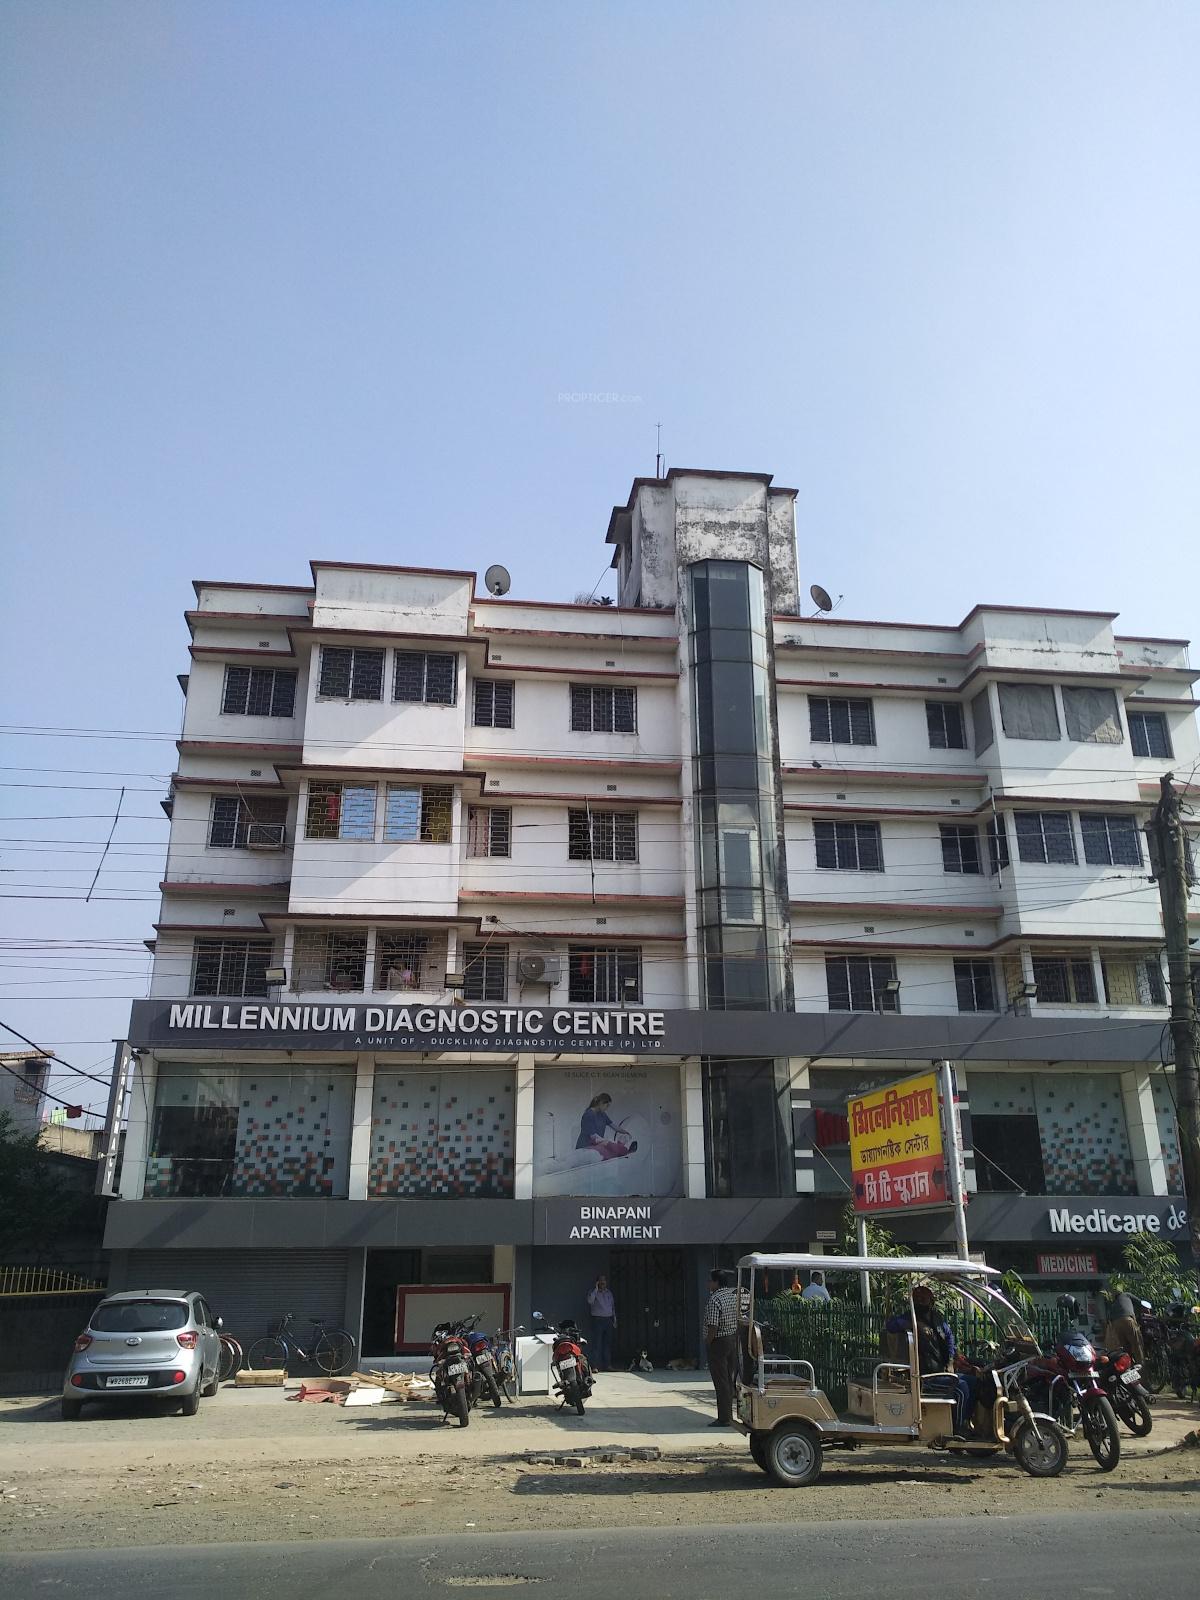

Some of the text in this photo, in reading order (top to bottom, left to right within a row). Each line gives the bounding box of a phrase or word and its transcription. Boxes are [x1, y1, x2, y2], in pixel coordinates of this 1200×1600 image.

[169, 1004, 665, 1036] MILLENNIUM DIAGNOSTIC CENTRE
[401, 1037, 415, 1045] OF
[431, 1038, 489, 1046] DUCKLING
[495, 1039, 565, 1047] DIAGNOSTIC
[571, 1039, 614, 1048] CENTRE
[620, 1040, 636, 1049] (P)
[852, 1088, 934, 1137] মিলেনিয়াম
[904, 1133, 929, 1154] সেন্টার
[580, 1206, 651, 1219] BINAPANI
[1049, 1208, 1161, 1233] Medicare
[569, 1225, 662, 1239] APARTMENT
[1040, 1256, 1094, 1273] MEDICINE
